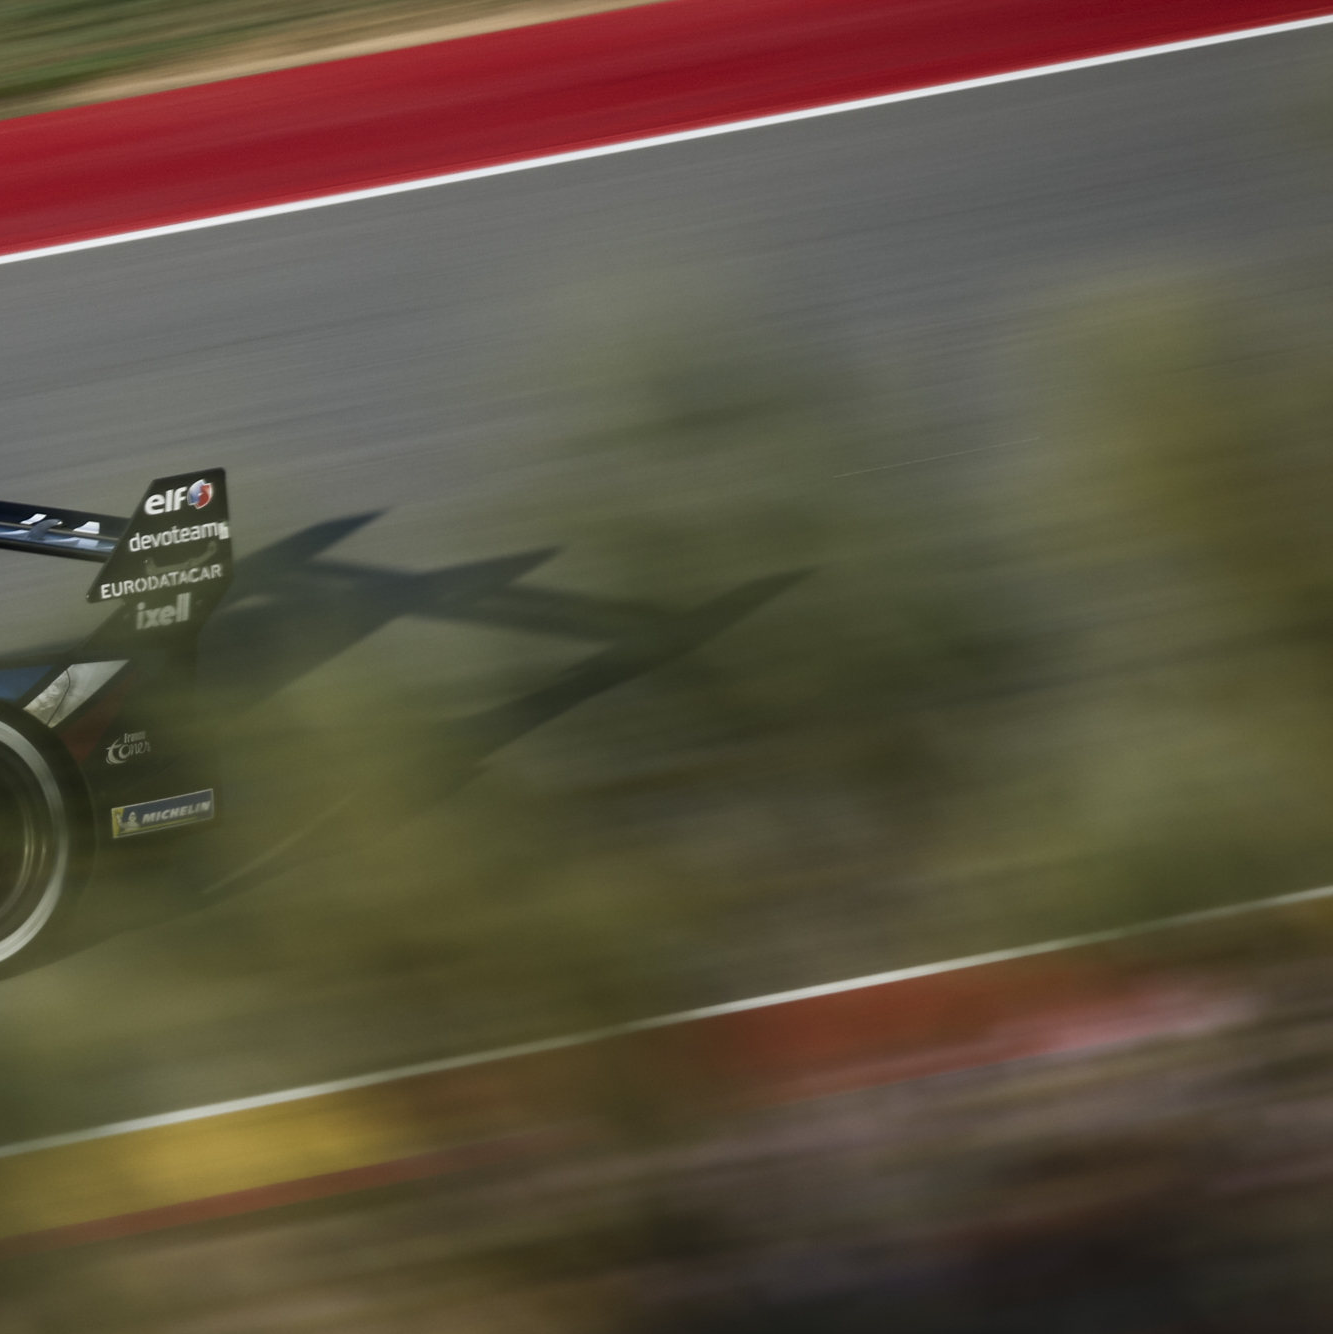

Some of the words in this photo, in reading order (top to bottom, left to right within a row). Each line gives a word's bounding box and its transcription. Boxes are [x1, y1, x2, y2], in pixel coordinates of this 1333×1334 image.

[144, 486, 187, 515] elf
[129, 521, 218, 552] devoteam
[100, 563, 223, 599] EURODATACAR
[136, 592, 191, 630] ixell
[142, 801, 211, 824] MICHELIN
